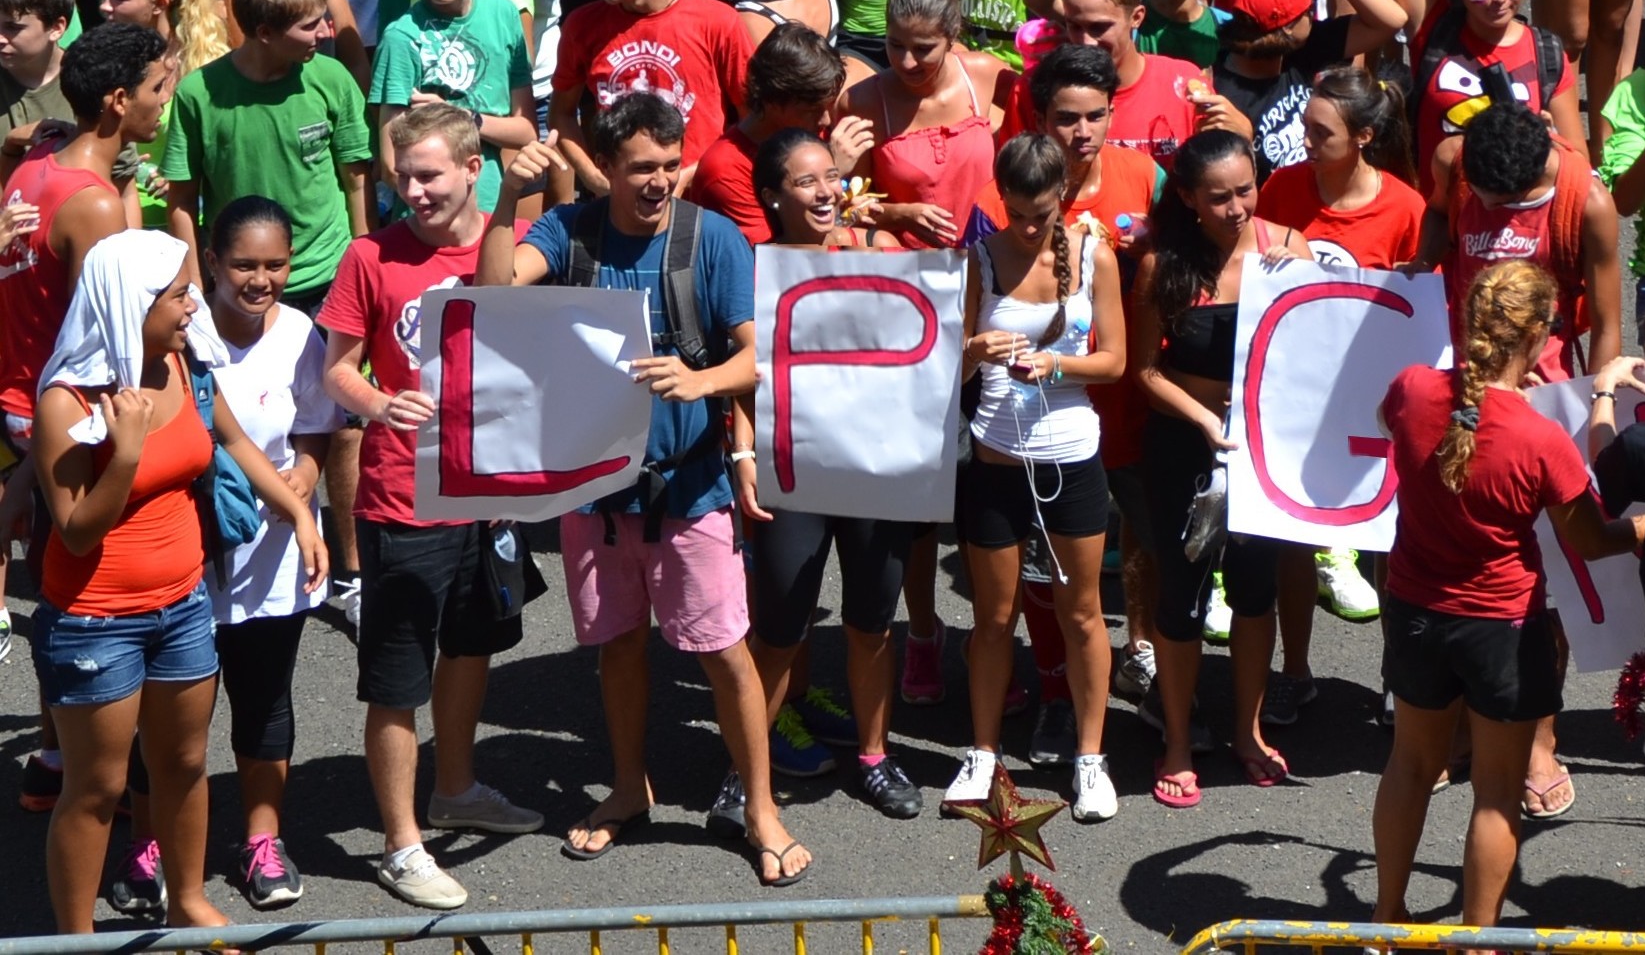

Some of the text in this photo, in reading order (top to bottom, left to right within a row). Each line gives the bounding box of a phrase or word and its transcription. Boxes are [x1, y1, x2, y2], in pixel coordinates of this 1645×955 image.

[606, 40, 681, 67] BONDI
[439, 298, 632, 498] L
[772, 273, 938, 494] P
